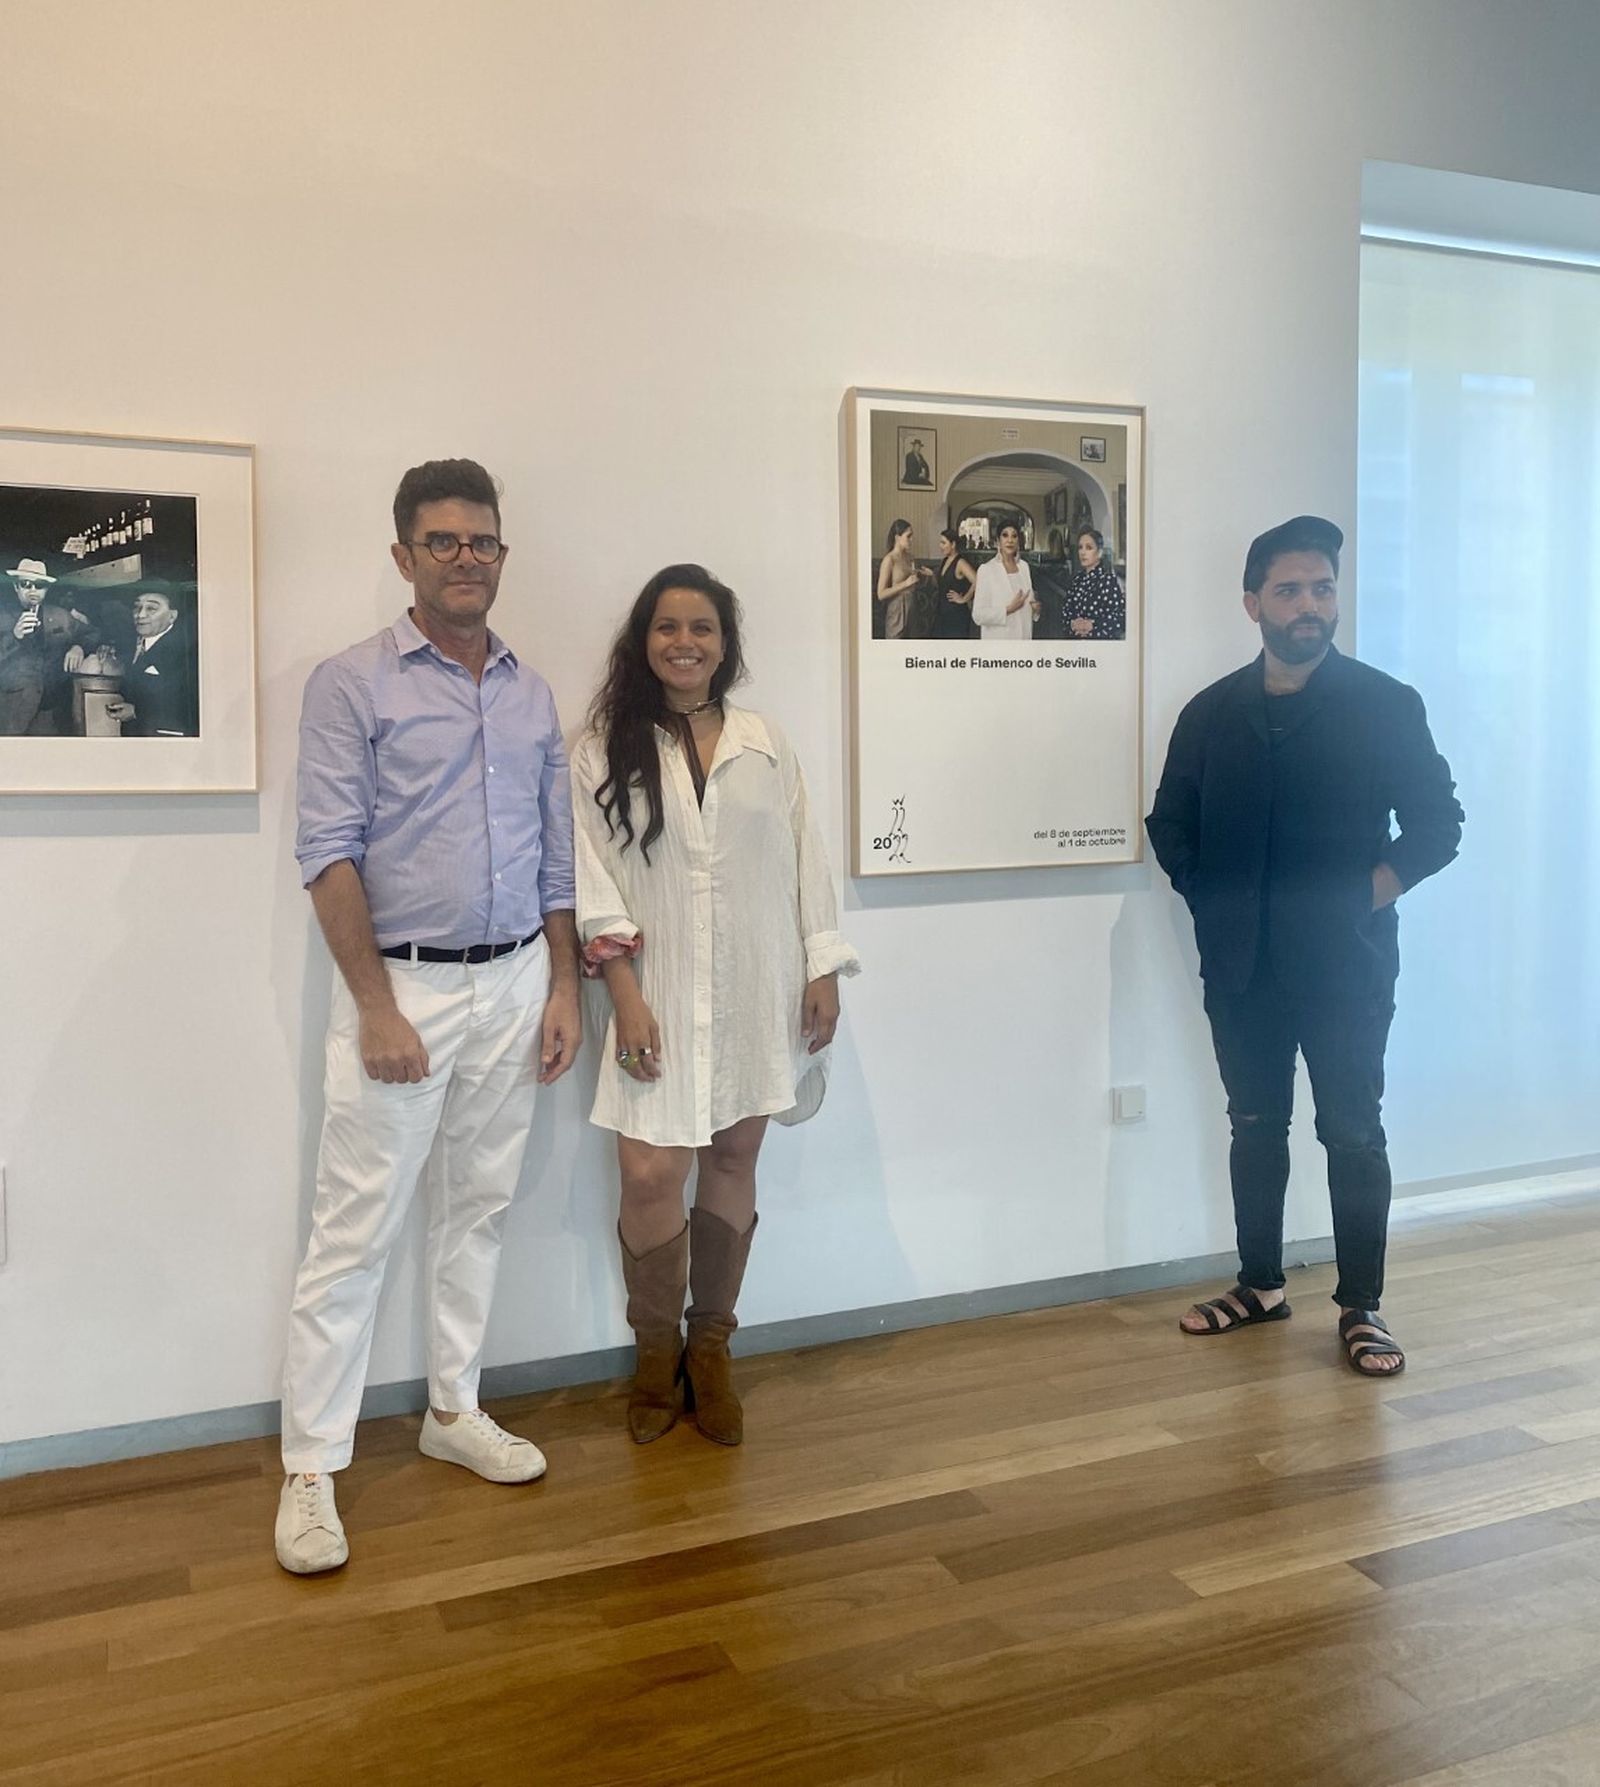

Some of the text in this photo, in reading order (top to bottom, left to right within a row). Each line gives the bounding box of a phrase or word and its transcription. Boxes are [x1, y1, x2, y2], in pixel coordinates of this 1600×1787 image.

[905, 656, 1097, 668] Bienal de Flamenco de Sevilla
[1034, 828, 1126, 839] del 8 de septiembre
[1057, 838, 1126, 848] al 1 de octubre
